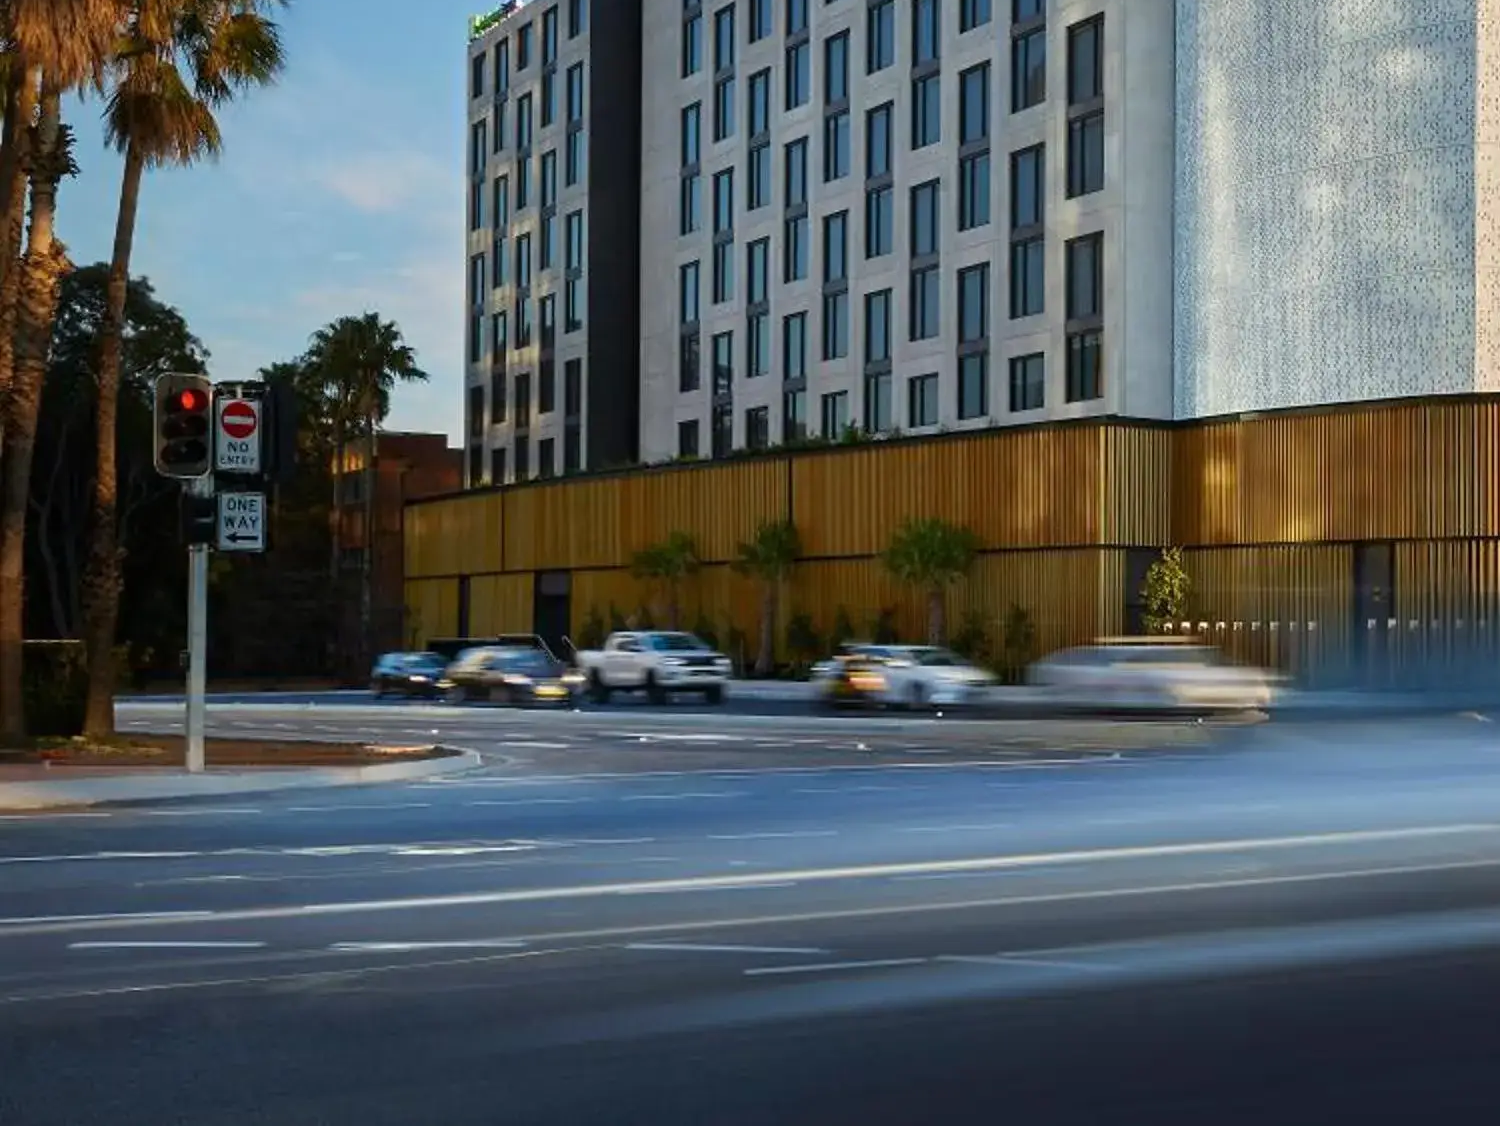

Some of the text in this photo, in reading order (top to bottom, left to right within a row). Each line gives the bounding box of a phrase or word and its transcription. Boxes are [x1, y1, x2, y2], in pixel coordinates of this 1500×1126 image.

[227, 441, 248, 453] NO
[220, 456, 255, 465] ENTRY
[226, 498, 257, 513] ONE
[224, 516, 258, 529] WAY
